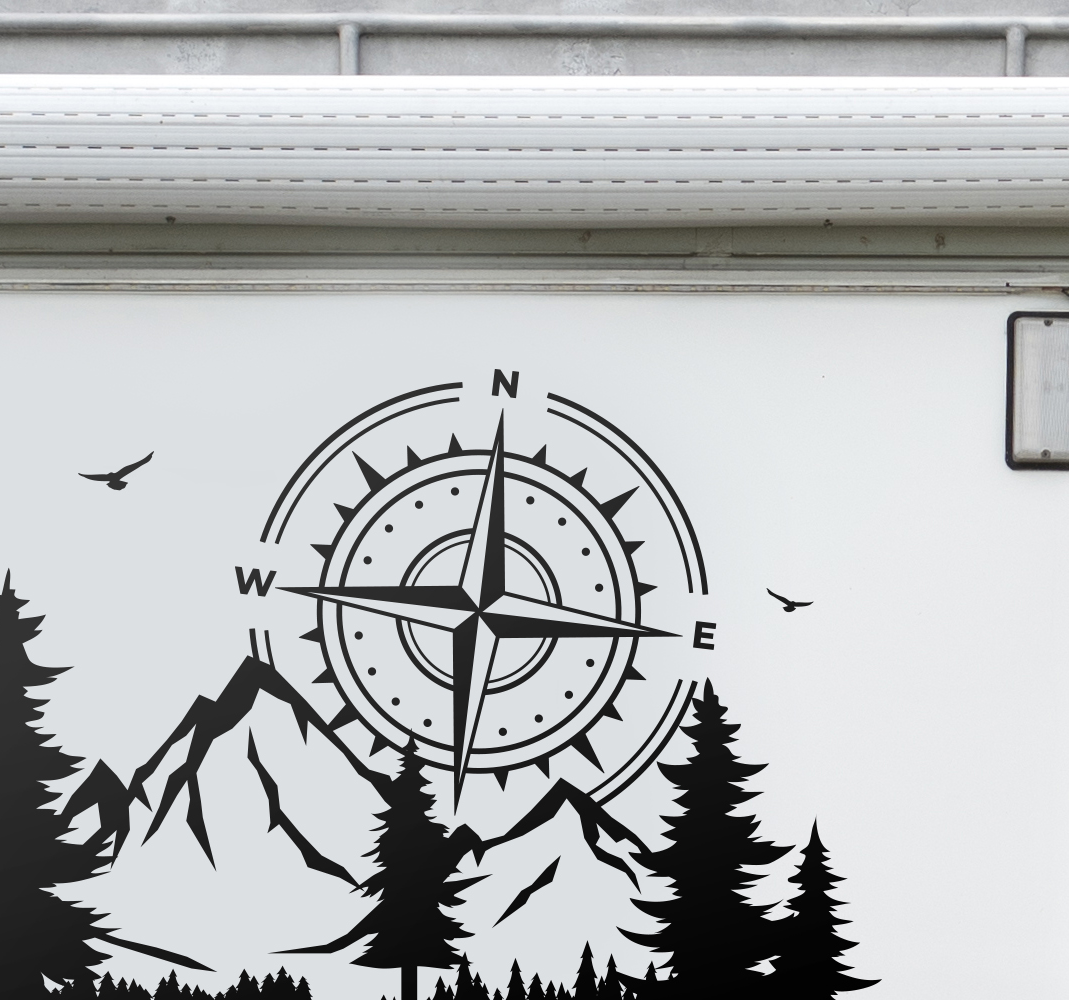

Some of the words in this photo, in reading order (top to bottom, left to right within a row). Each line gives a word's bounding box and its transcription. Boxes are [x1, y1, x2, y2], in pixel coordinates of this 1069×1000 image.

[491, 368, 520, 399] N
[234, 565, 277, 598] W
[692, 620, 717, 651] E
